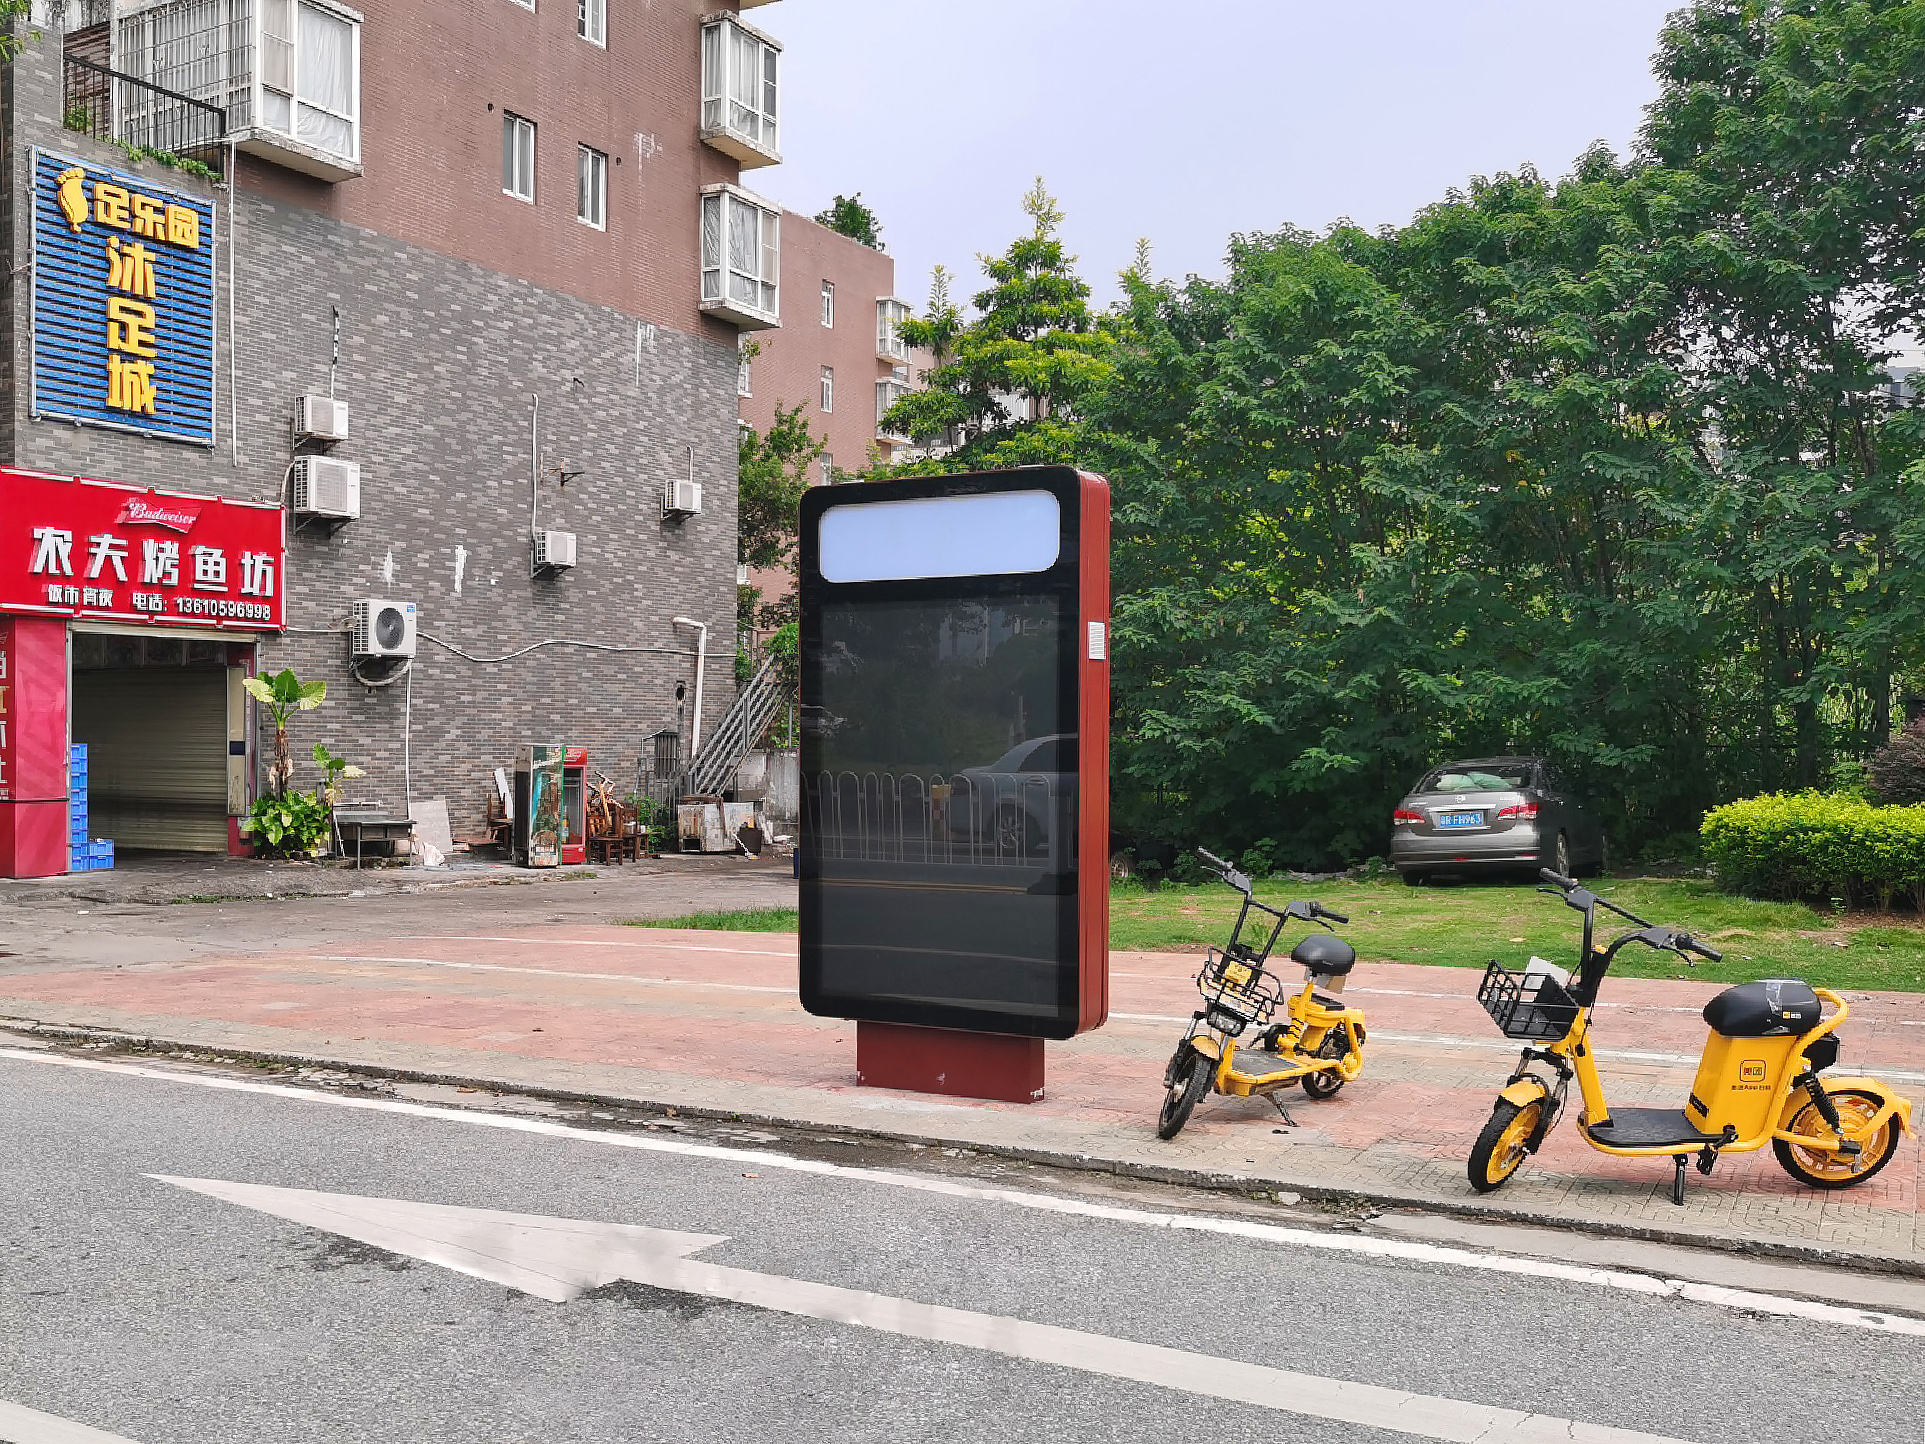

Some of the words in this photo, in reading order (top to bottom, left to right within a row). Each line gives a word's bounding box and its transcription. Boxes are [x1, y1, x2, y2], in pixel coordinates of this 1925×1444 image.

[93, 181, 199, 249] 足乐园
[106, 236, 156, 414] 沐足城
[128, 503, 197, 525] Budweiser
[31, 526, 275, 597] 农夫烤鱼坊
[177, 597, 271, 620] 13610596998
